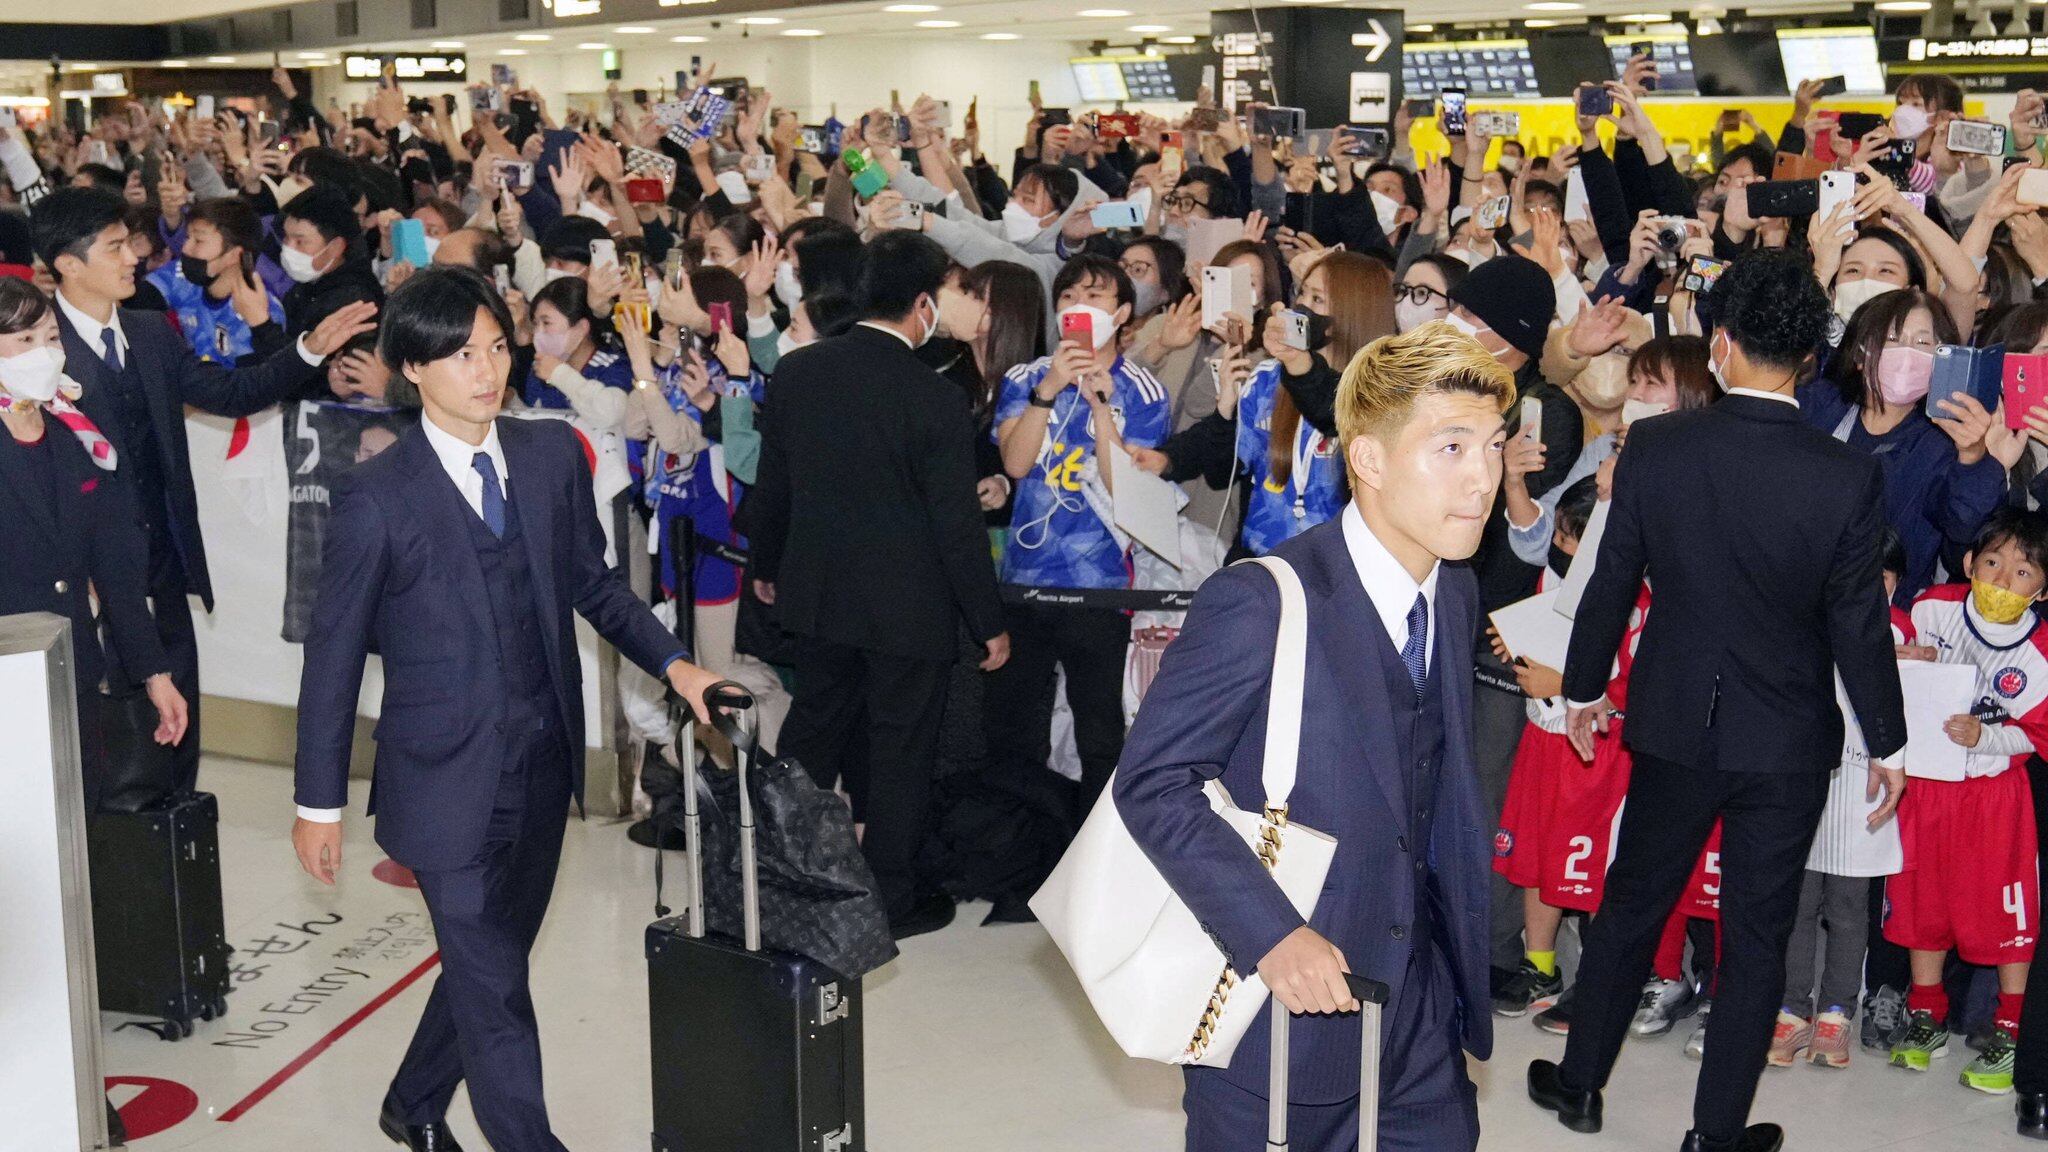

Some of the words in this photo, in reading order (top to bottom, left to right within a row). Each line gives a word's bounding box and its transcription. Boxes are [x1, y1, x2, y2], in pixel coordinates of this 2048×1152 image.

[295, 400, 320, 474] 5
[1476, 672, 1496, 685] Narita
[1496, 678, 1520, 693] Airport
[1564, 835, 1593, 880] 2
[1702, 851, 1722, 895] 5
[2003, 881, 2027, 931] 4
[211, 1020, 289, 1049] No
[260, 966, 370, 1015] Entry
